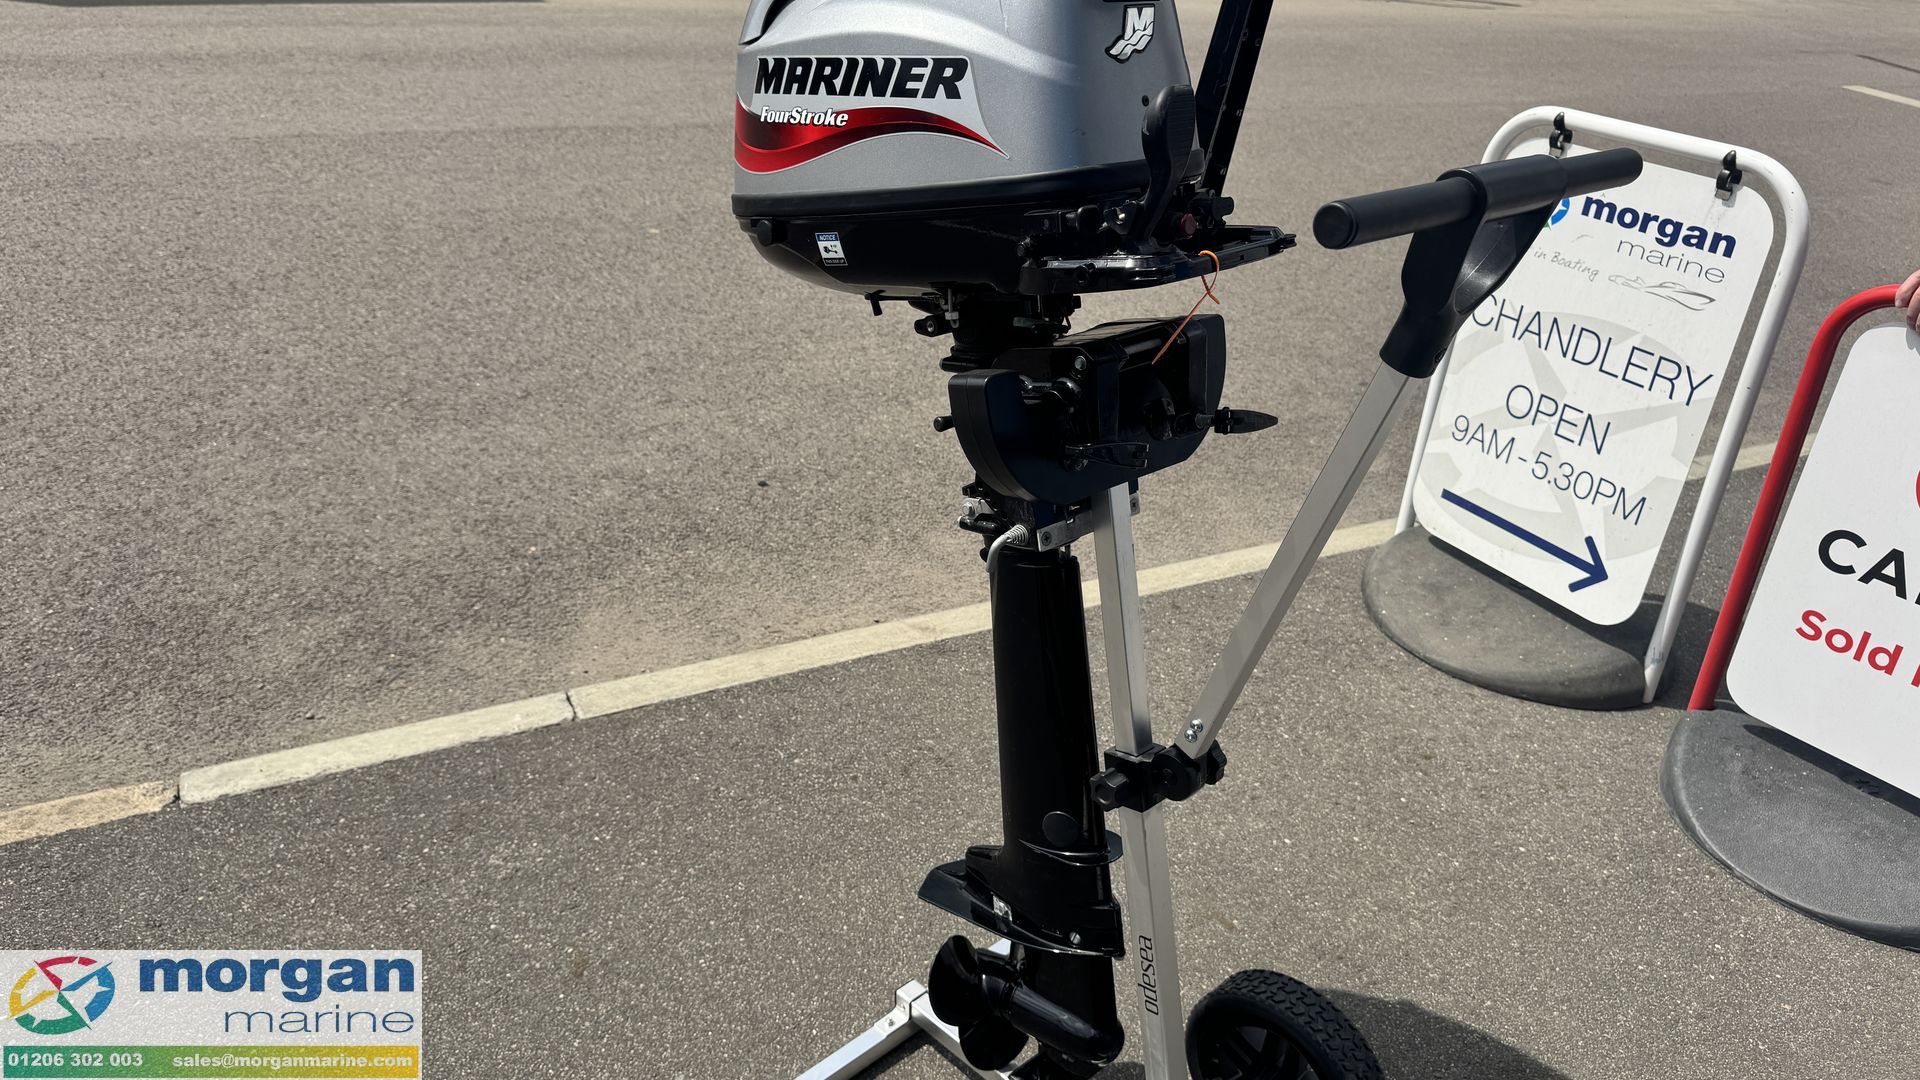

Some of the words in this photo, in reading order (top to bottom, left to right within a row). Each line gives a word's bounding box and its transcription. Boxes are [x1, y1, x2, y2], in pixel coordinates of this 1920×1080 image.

[754, 57, 968, 100] MARINER
[760, 106, 849, 127] FourStroke
[1581, 196, 1737, 258] morgan
[1550, 251, 1600, 282] Boating
[1616, 239, 1725, 283] marine
[1472, 294, 1714, 406] CHANDLERY
[1506, 384, 1611, 455] OPEN
[1818, 529, 1920, 606] CA
[1795, 609, 1904, 677] Sold
[1137, 935, 1159, 1016] odesea
